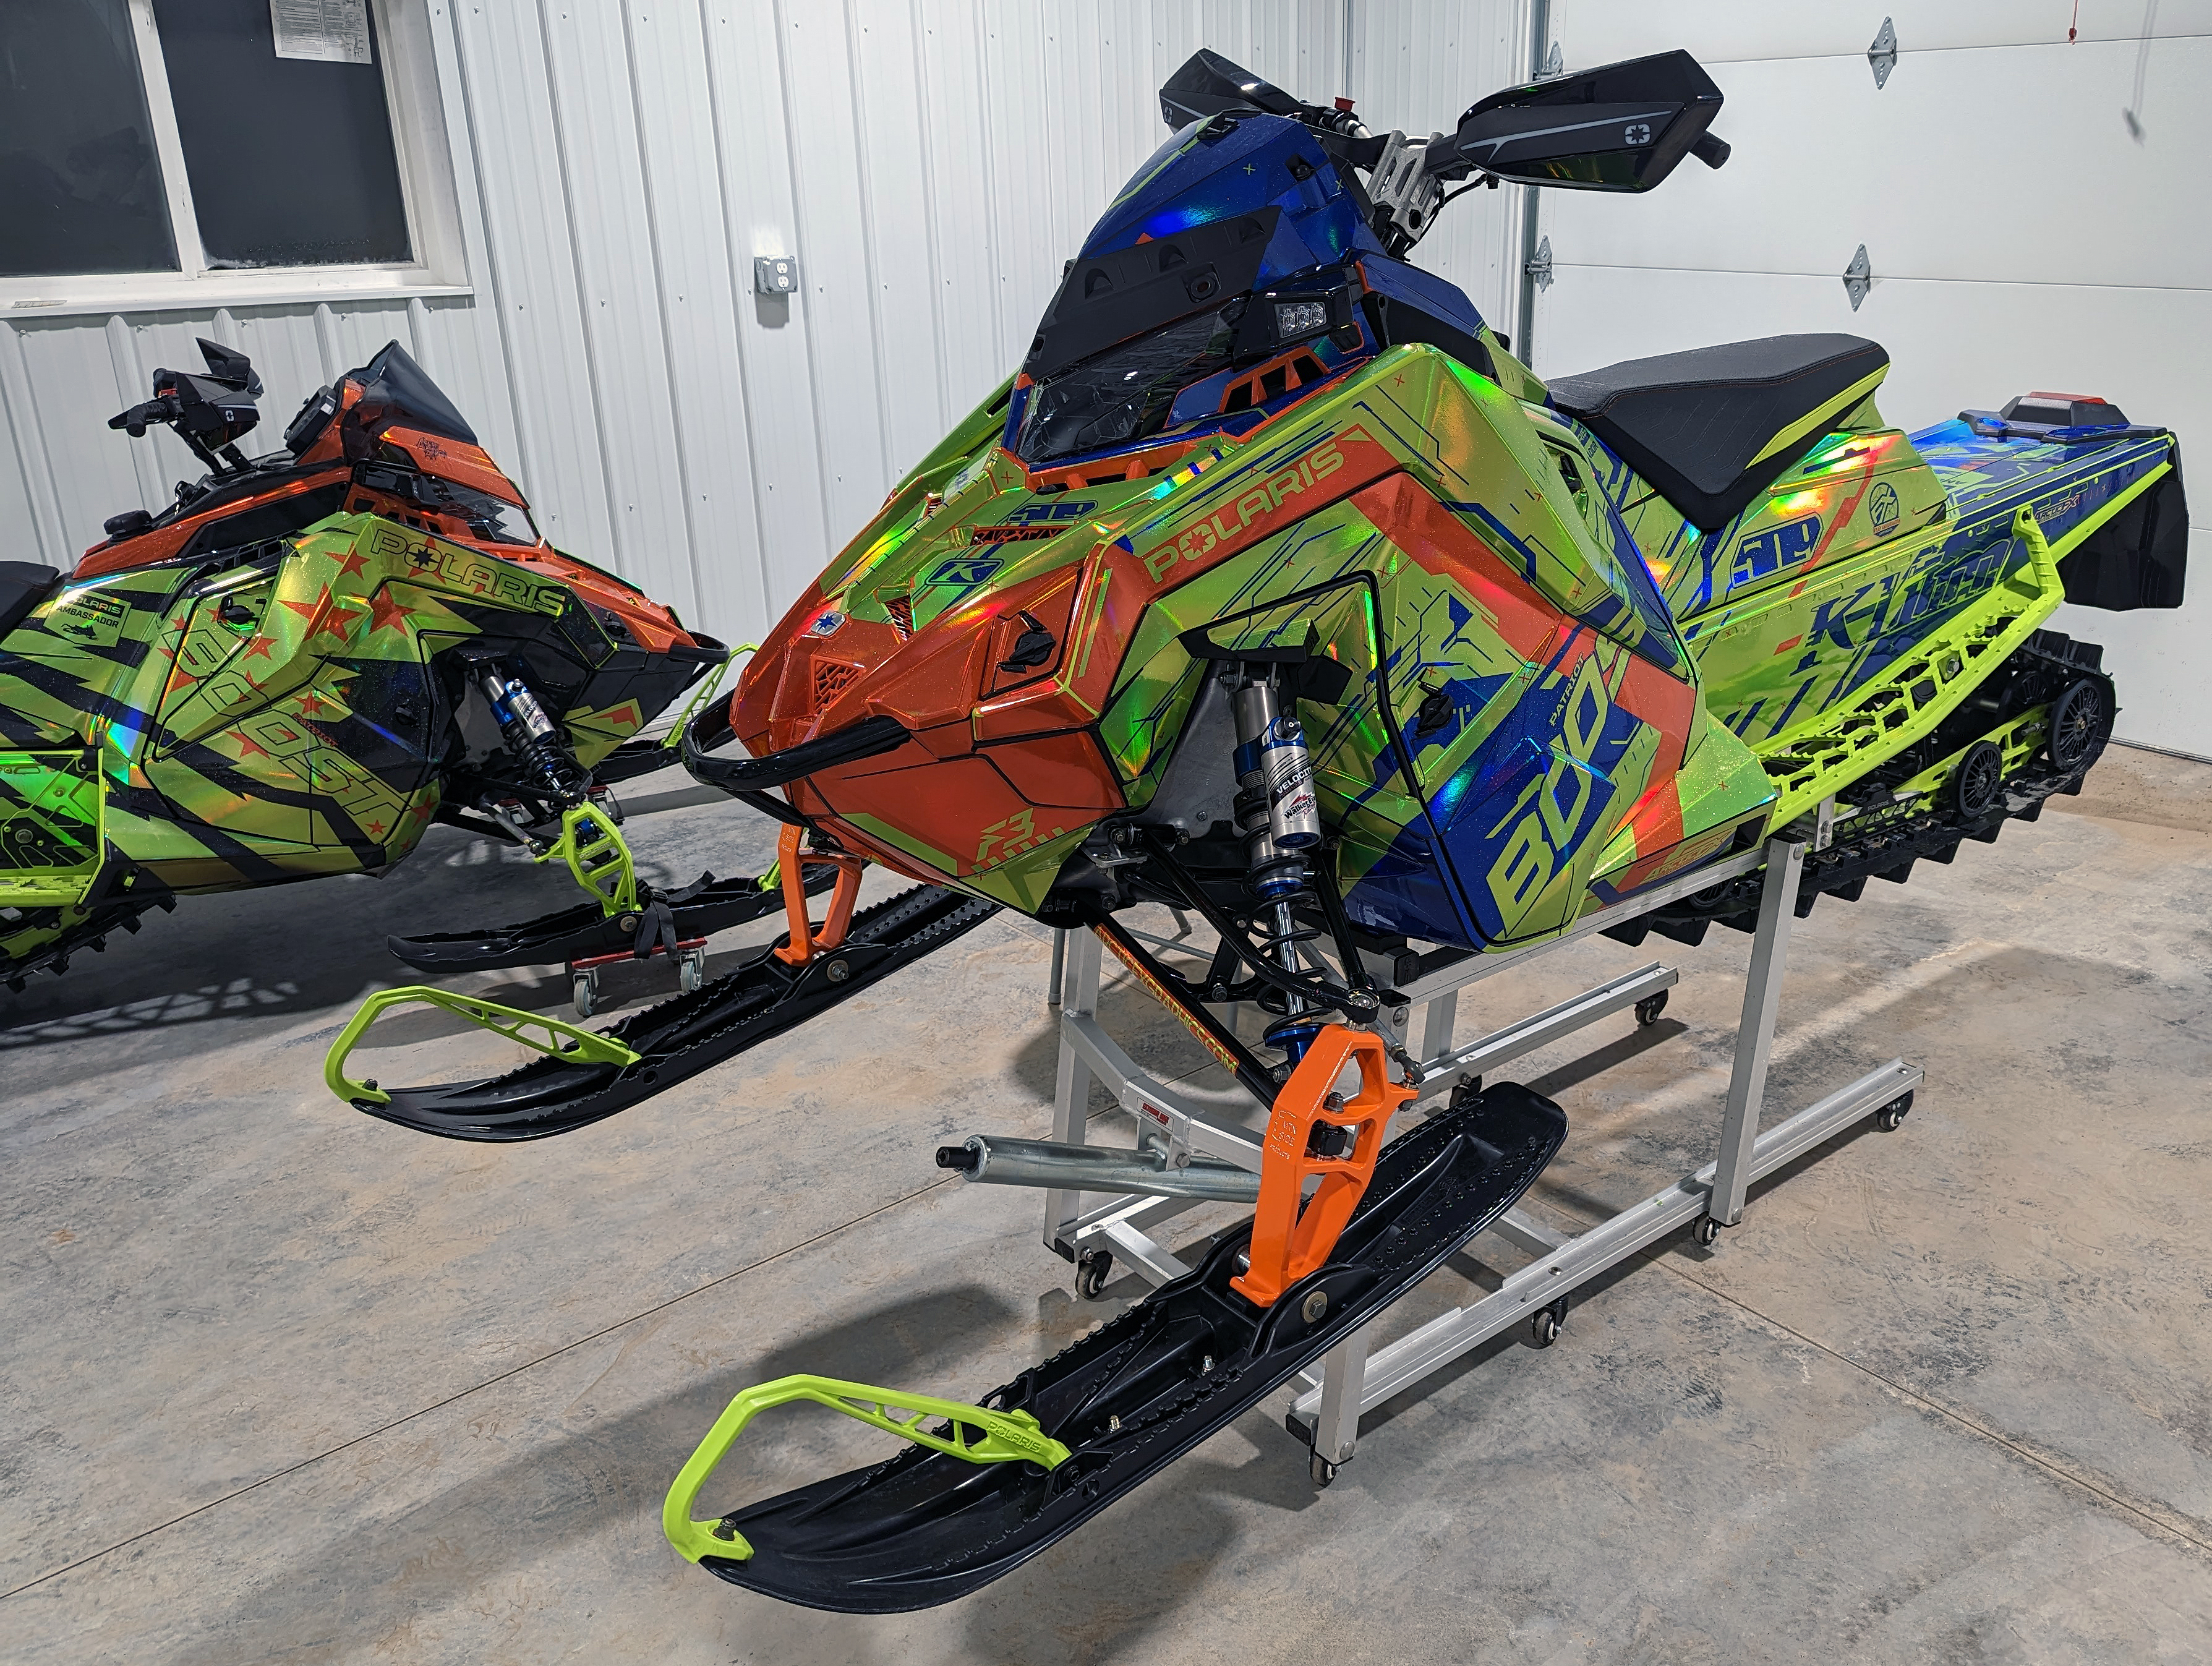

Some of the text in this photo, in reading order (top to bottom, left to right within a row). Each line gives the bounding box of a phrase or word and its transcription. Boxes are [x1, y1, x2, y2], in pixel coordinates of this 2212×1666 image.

[1143, 442, 1344, 584] POLARIS
[370, 528, 565, 617] POLARIS
[56, 605, 119, 628] AMBASSADOR
[72, 596, 121, 614] OLARIS
[1548, 652, 1584, 727] PATRIOT
[1867, 800, 1890, 812] POLARIS
[579, 841, 612, 859] POLARIS
[1278, 1131, 1296, 1147] SIDE
[986, 1420, 1042, 1453] POLARIS
